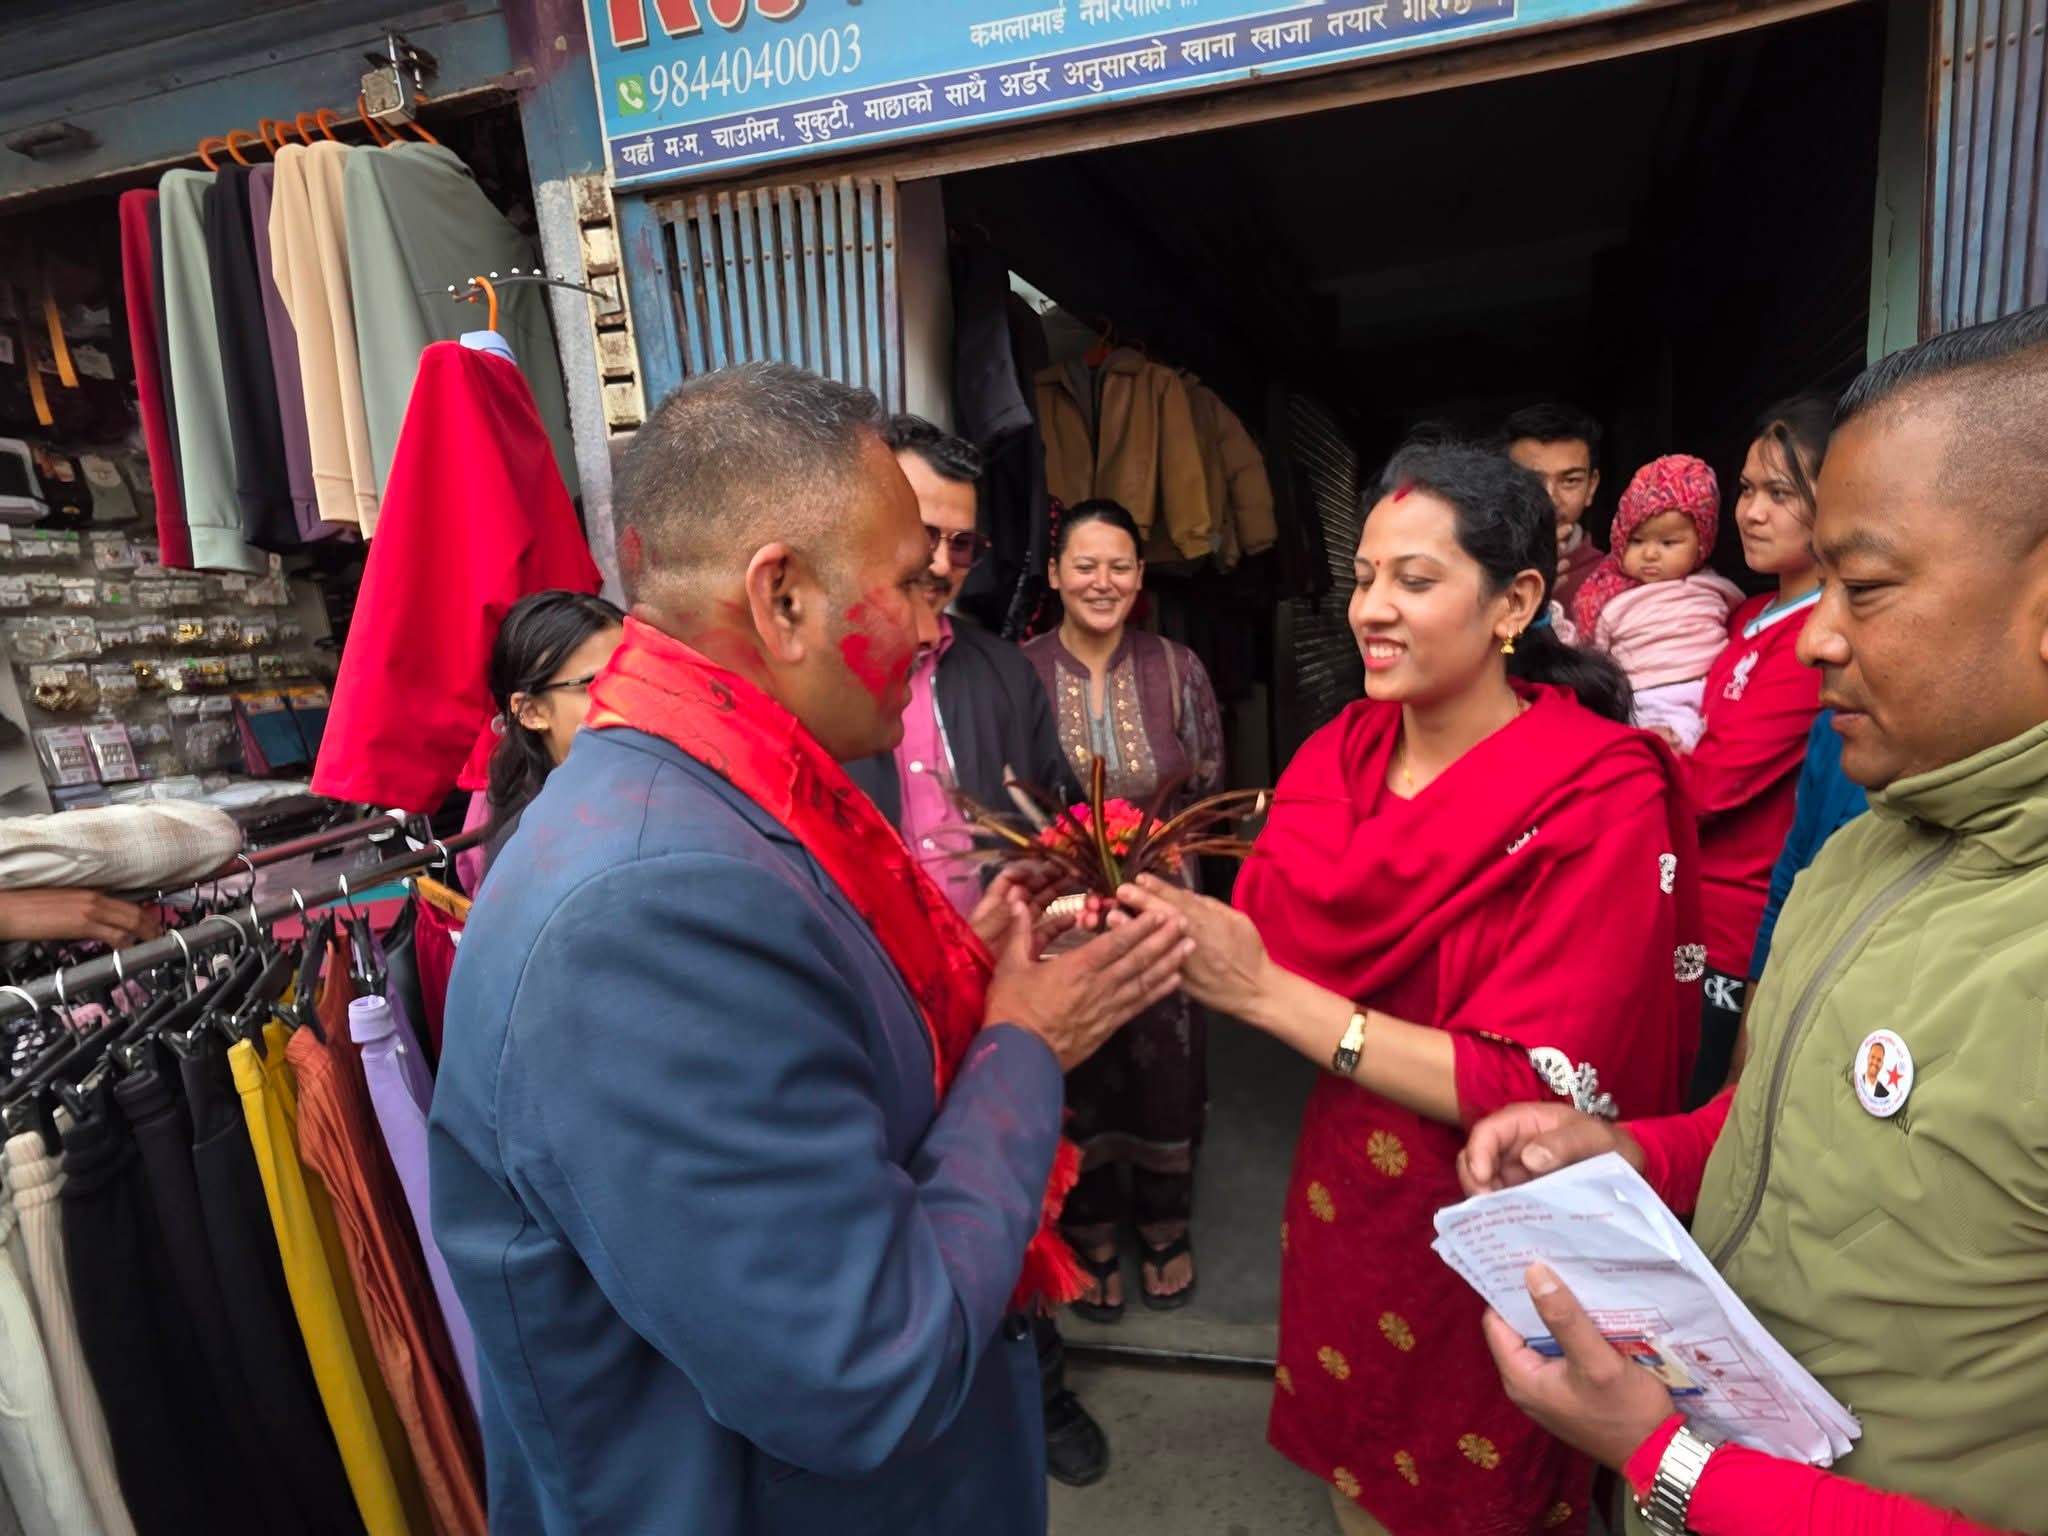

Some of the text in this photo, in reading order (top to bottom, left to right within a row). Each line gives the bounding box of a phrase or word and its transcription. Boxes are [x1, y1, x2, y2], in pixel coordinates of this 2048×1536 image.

[621, 136, 655, 167] यहाँ
[864, 82, 933, 122] माछाको
[944, 72, 987, 107] साथै
[1000, 61, 1051, 98] अर्डर
[1063, 39, 1168, 92] अनुसारको
[1181, 33, 1237, 66] खाना
[1250, 18, 1312, 53] खाजा
[1328, 4, 1388, 37] तयार
[649, 23, 862, 112] 9844040003
